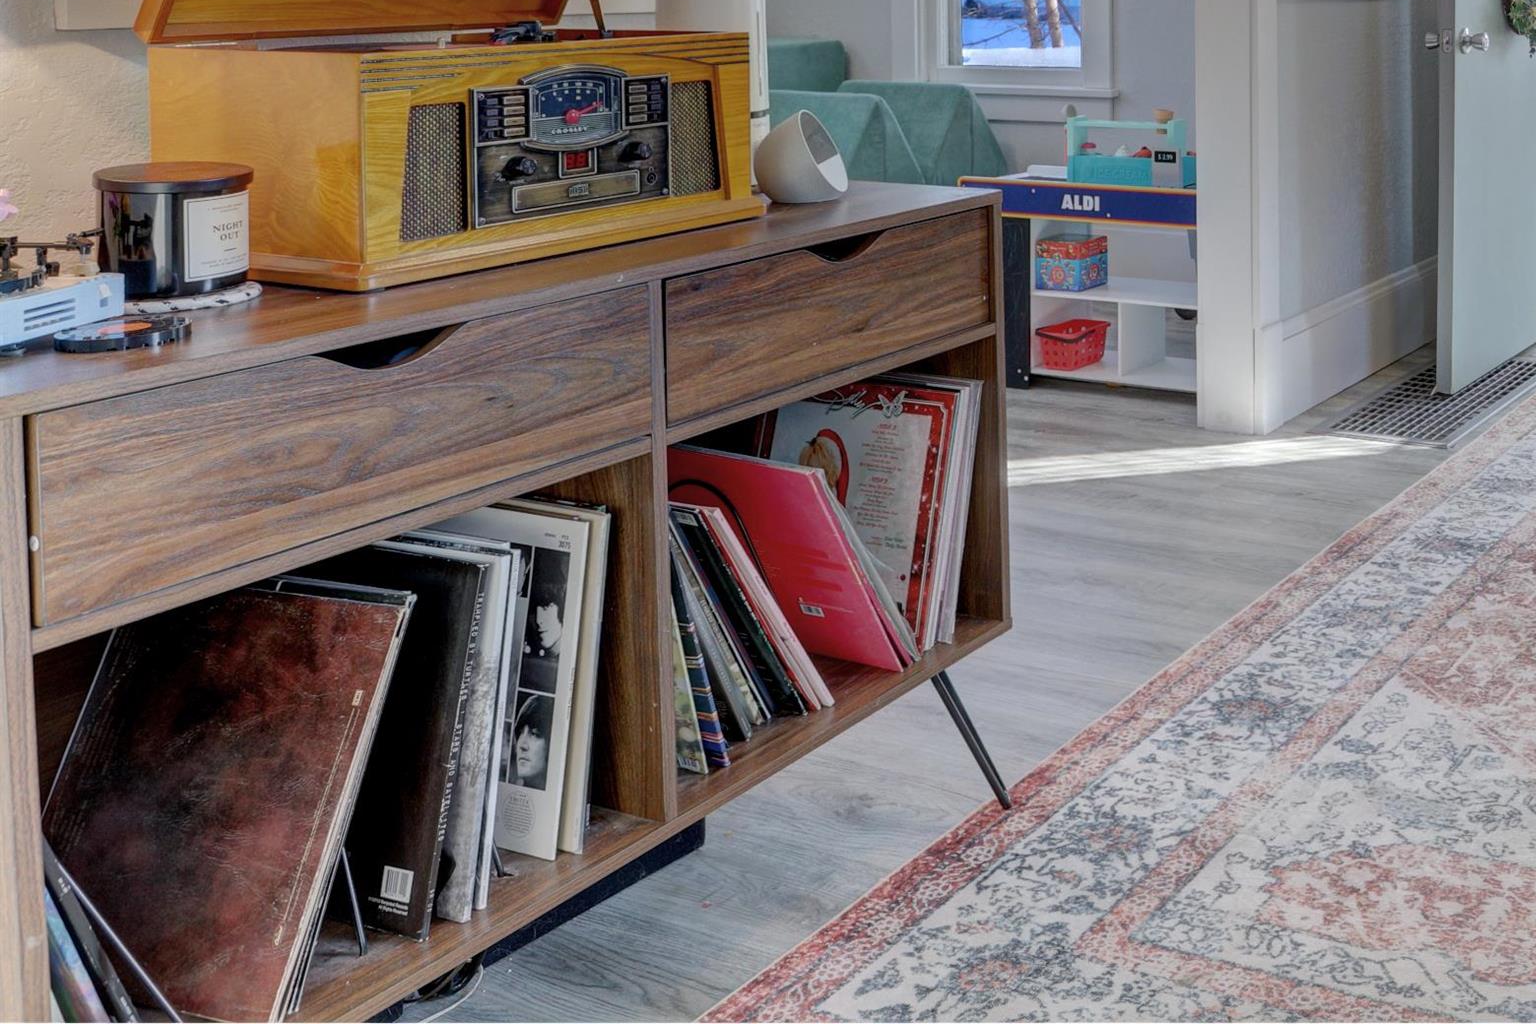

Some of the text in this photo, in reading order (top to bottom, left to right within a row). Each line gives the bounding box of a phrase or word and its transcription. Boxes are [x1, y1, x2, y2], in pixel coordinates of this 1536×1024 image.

[1061, 194, 1101, 212] ALDI
[213, 220, 243, 232] NIGHT
[220, 231, 240, 241] OUT
[471, 592, 484, 636] TRAMPLED
[469, 643, 476, 653] BY
